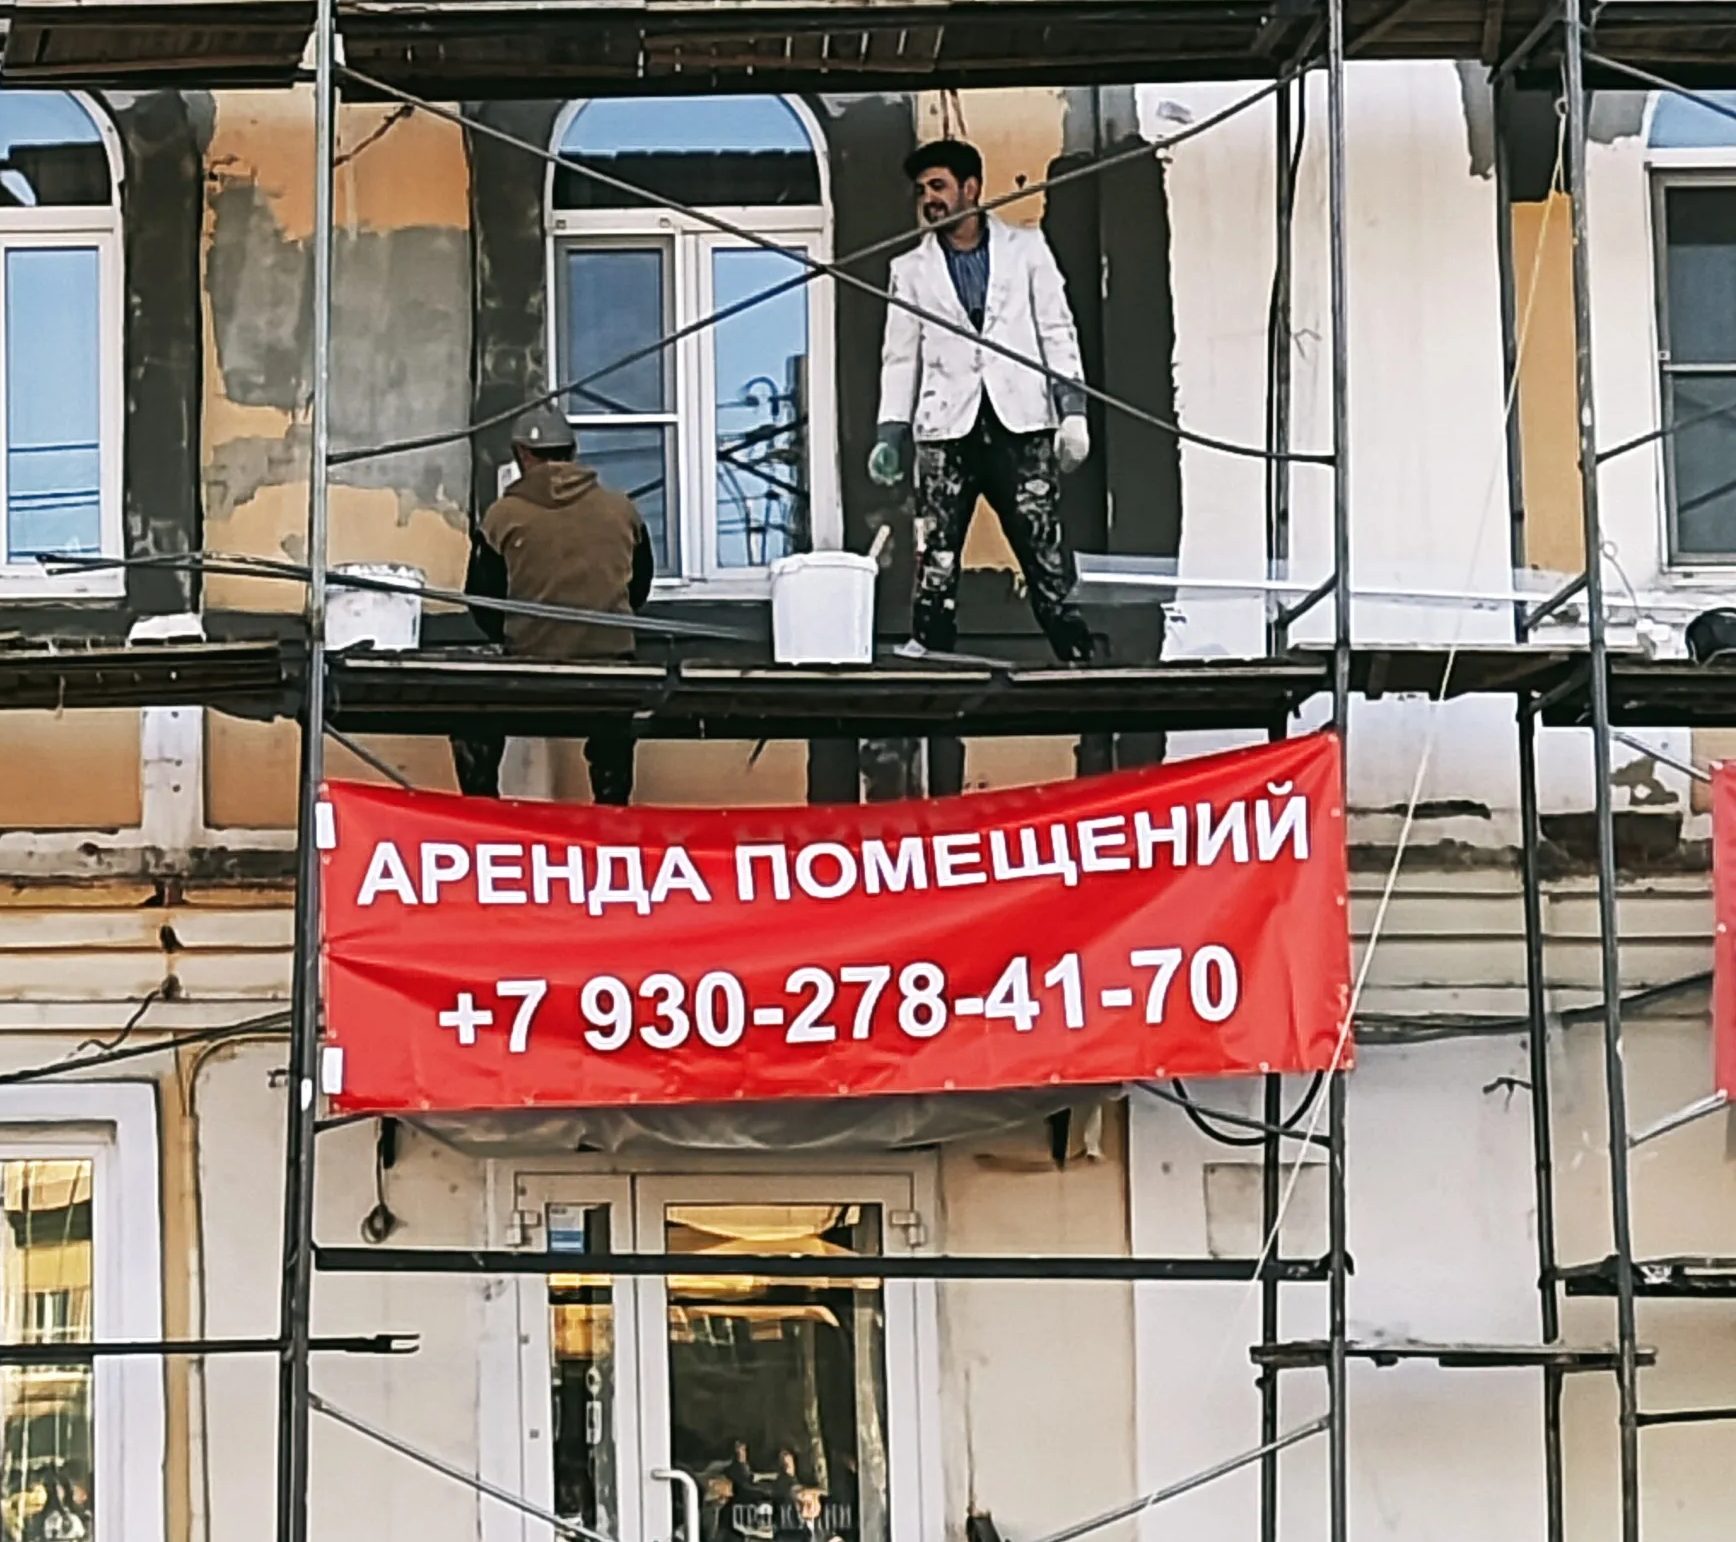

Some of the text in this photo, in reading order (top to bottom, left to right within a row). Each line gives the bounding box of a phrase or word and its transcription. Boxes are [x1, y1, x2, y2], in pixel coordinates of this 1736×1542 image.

[357, 781, 1310, 917] АРЕНДА ПОМЕЩЕНИЙ
[437, 944, 1242, 1054] +7 930-278-41-70
